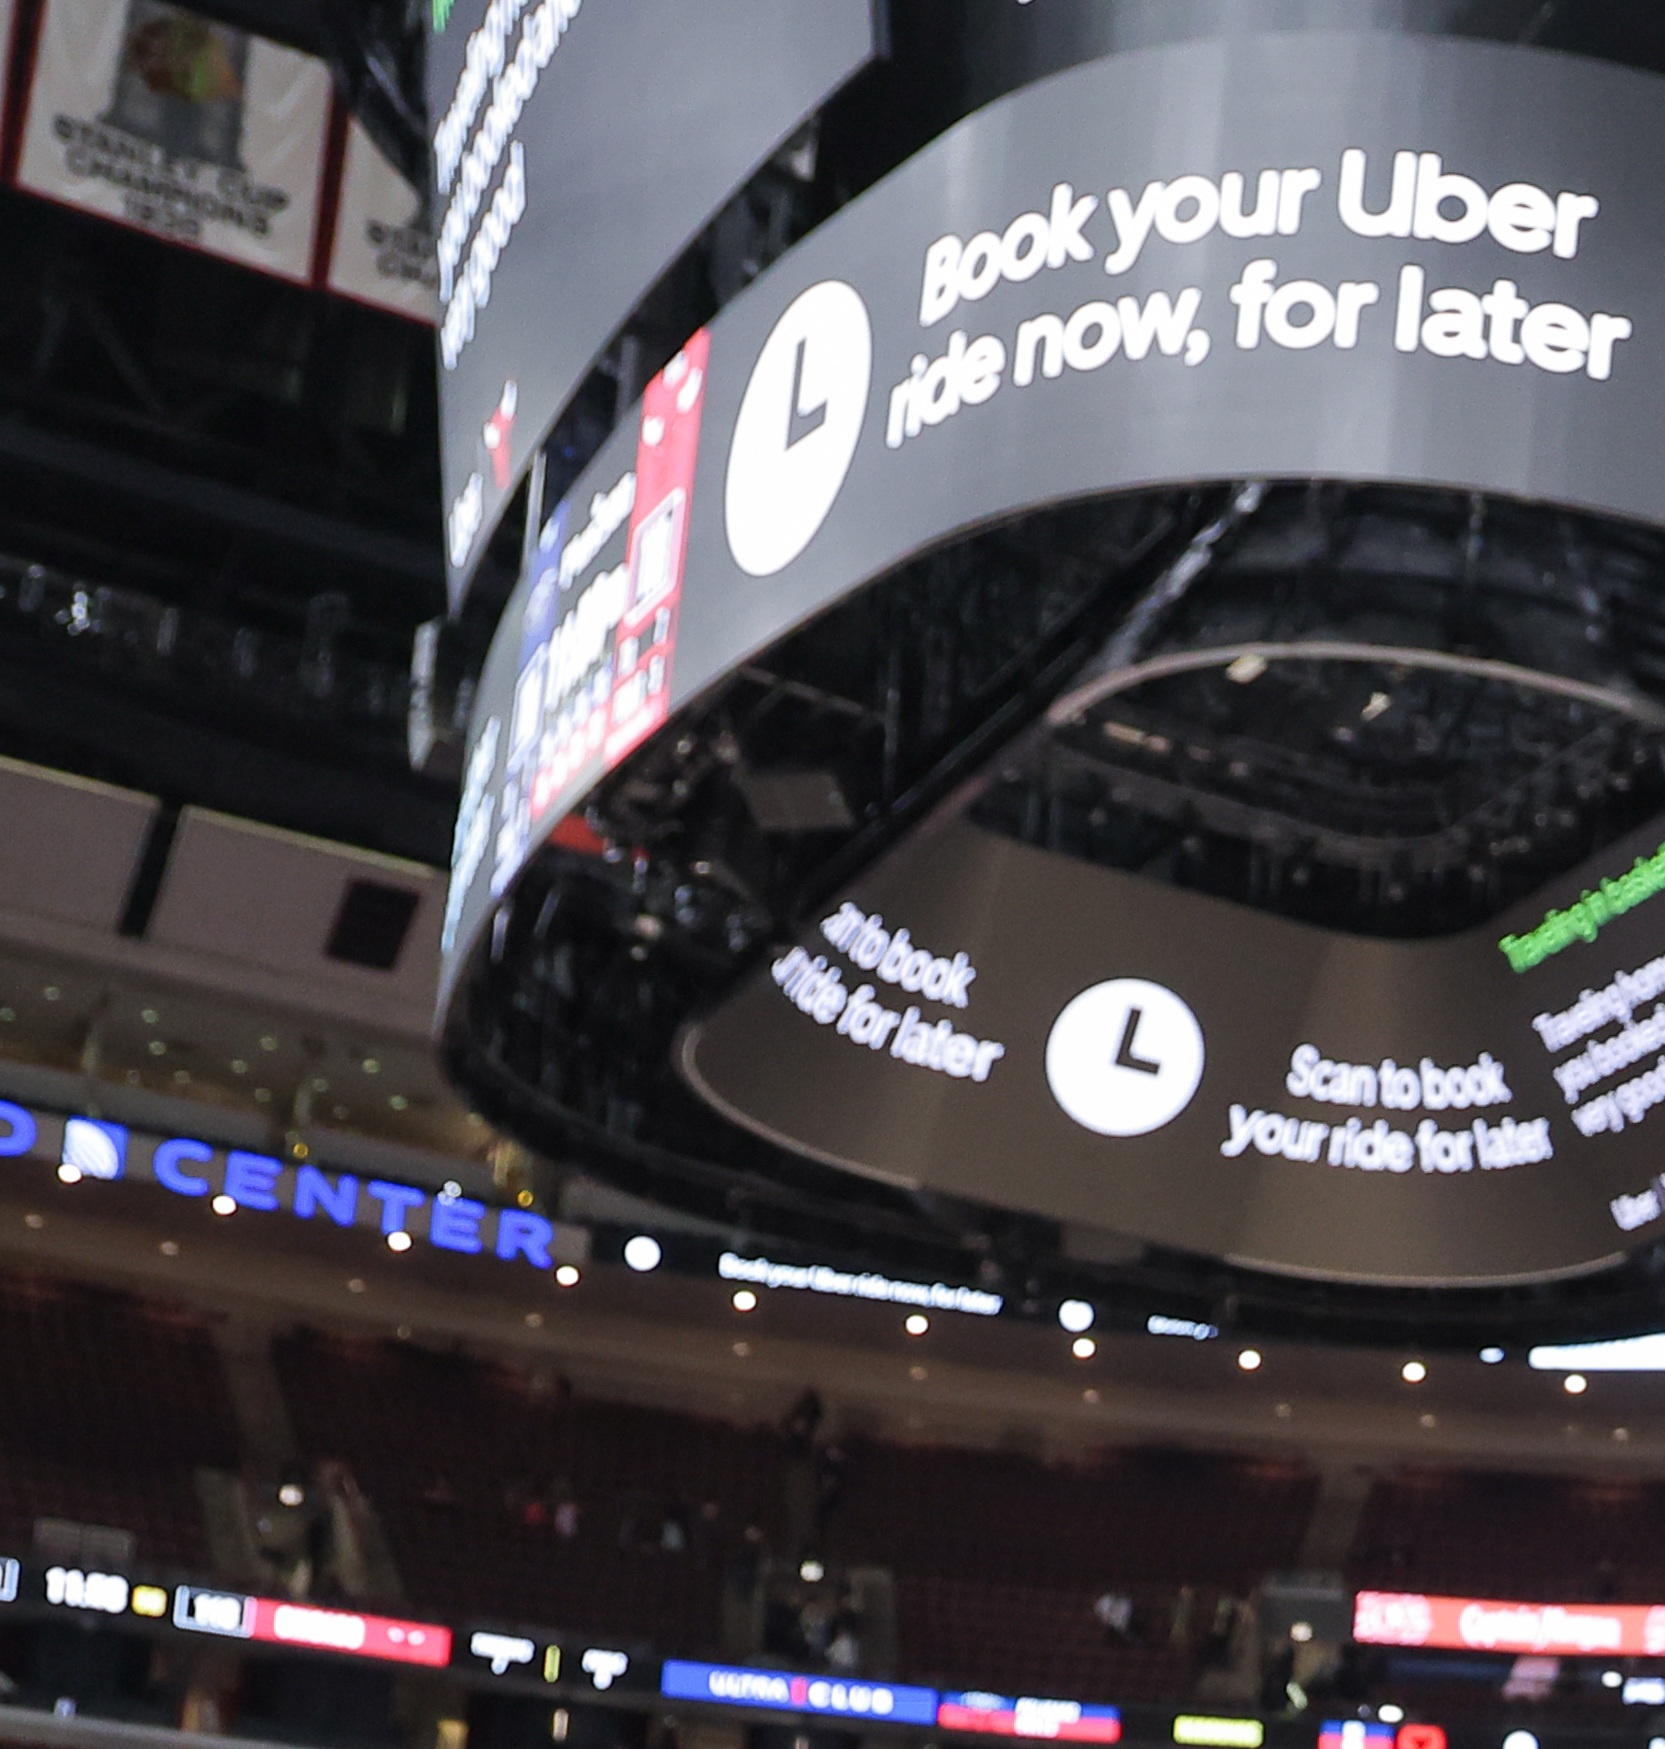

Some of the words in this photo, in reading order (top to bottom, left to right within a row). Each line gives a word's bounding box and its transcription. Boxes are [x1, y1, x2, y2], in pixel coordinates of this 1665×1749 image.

[920, 183, 1095, 327] Book
[1108, 168, 1321, 275] your
[1338, 149, 1597, 258] Uber
[886, 330, 1005, 448] ride
[1014, 287, 1210, 386] now,
[1230, 259, 1379, 349] for
[1395, 265, 1631, 379] later
[876, 927, 977, 1009] book
[836, 983, 902, 1050] for
[889, 1005, 1006, 1083] later
[1286, 1043, 1380, 1107] Scan
[1378, 1057, 1422, 1111] to
[1419, 1051, 1513, 1111] book
[1220, 1103, 1330, 1163] your
[1327, 1116, 1415, 1173] ride
[1414, 1118, 1474, 1173] for
[1472, 1116, 1554, 1171] later
[153, 1139, 553, 1270] CENTER
